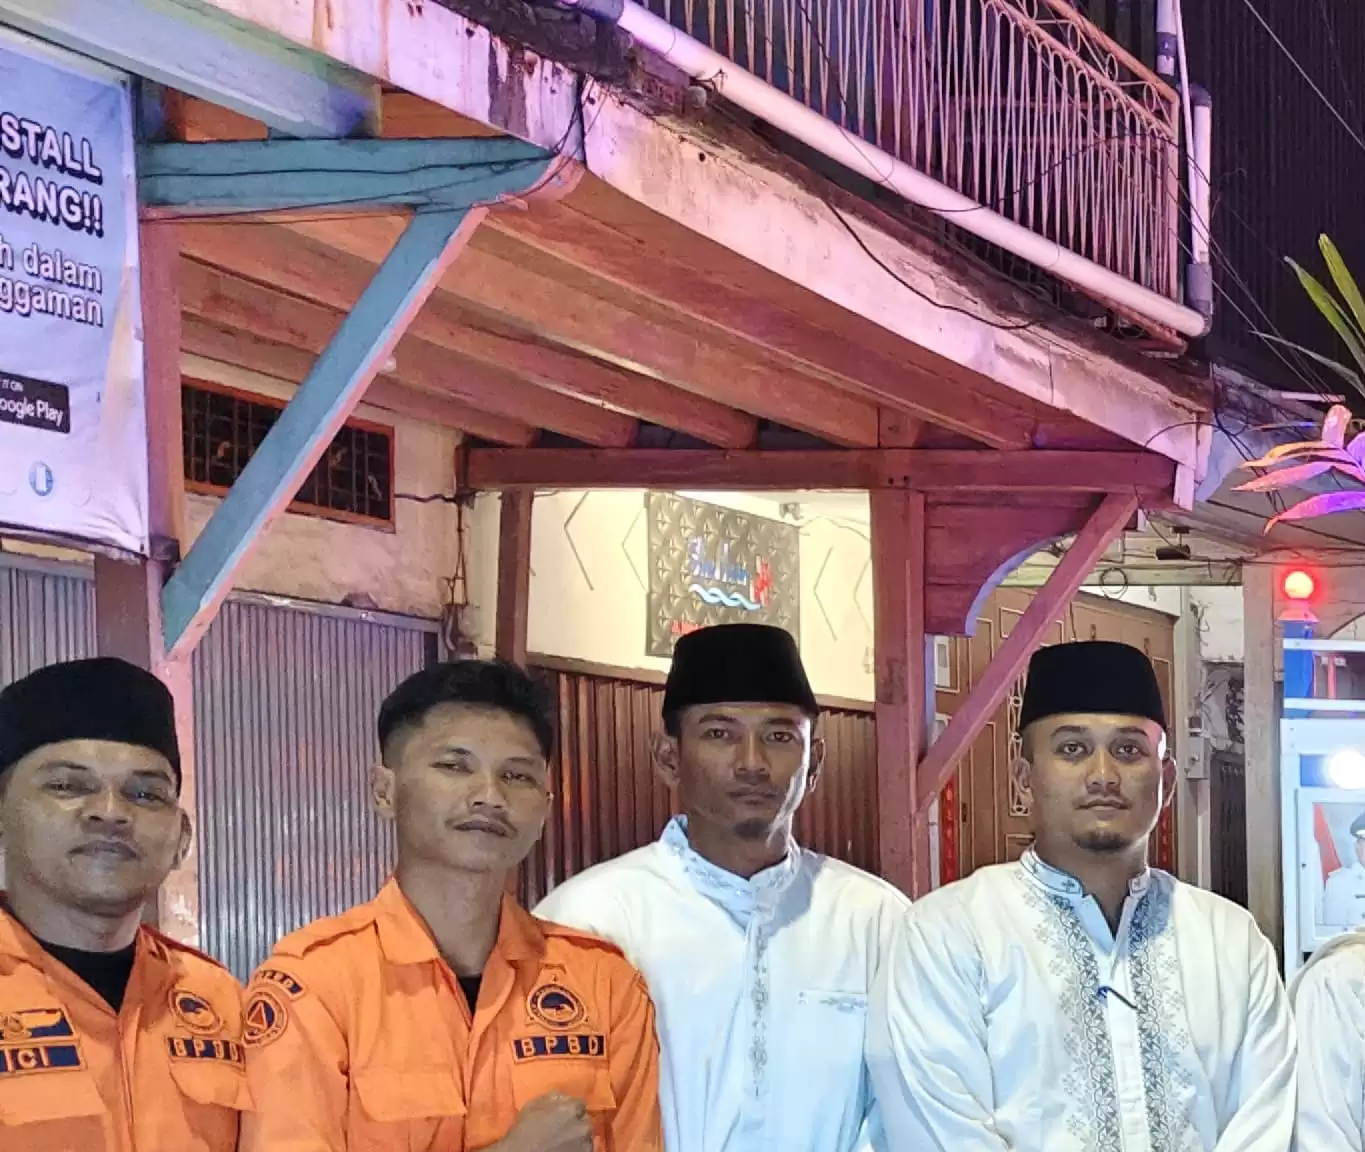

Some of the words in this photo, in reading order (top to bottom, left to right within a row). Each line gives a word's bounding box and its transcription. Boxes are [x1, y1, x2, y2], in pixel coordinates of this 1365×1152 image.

[23, 242, 102, 294] dalam
[36, 400, 63, 427] Play
[522, 1036, 599, 1057] BPBD
